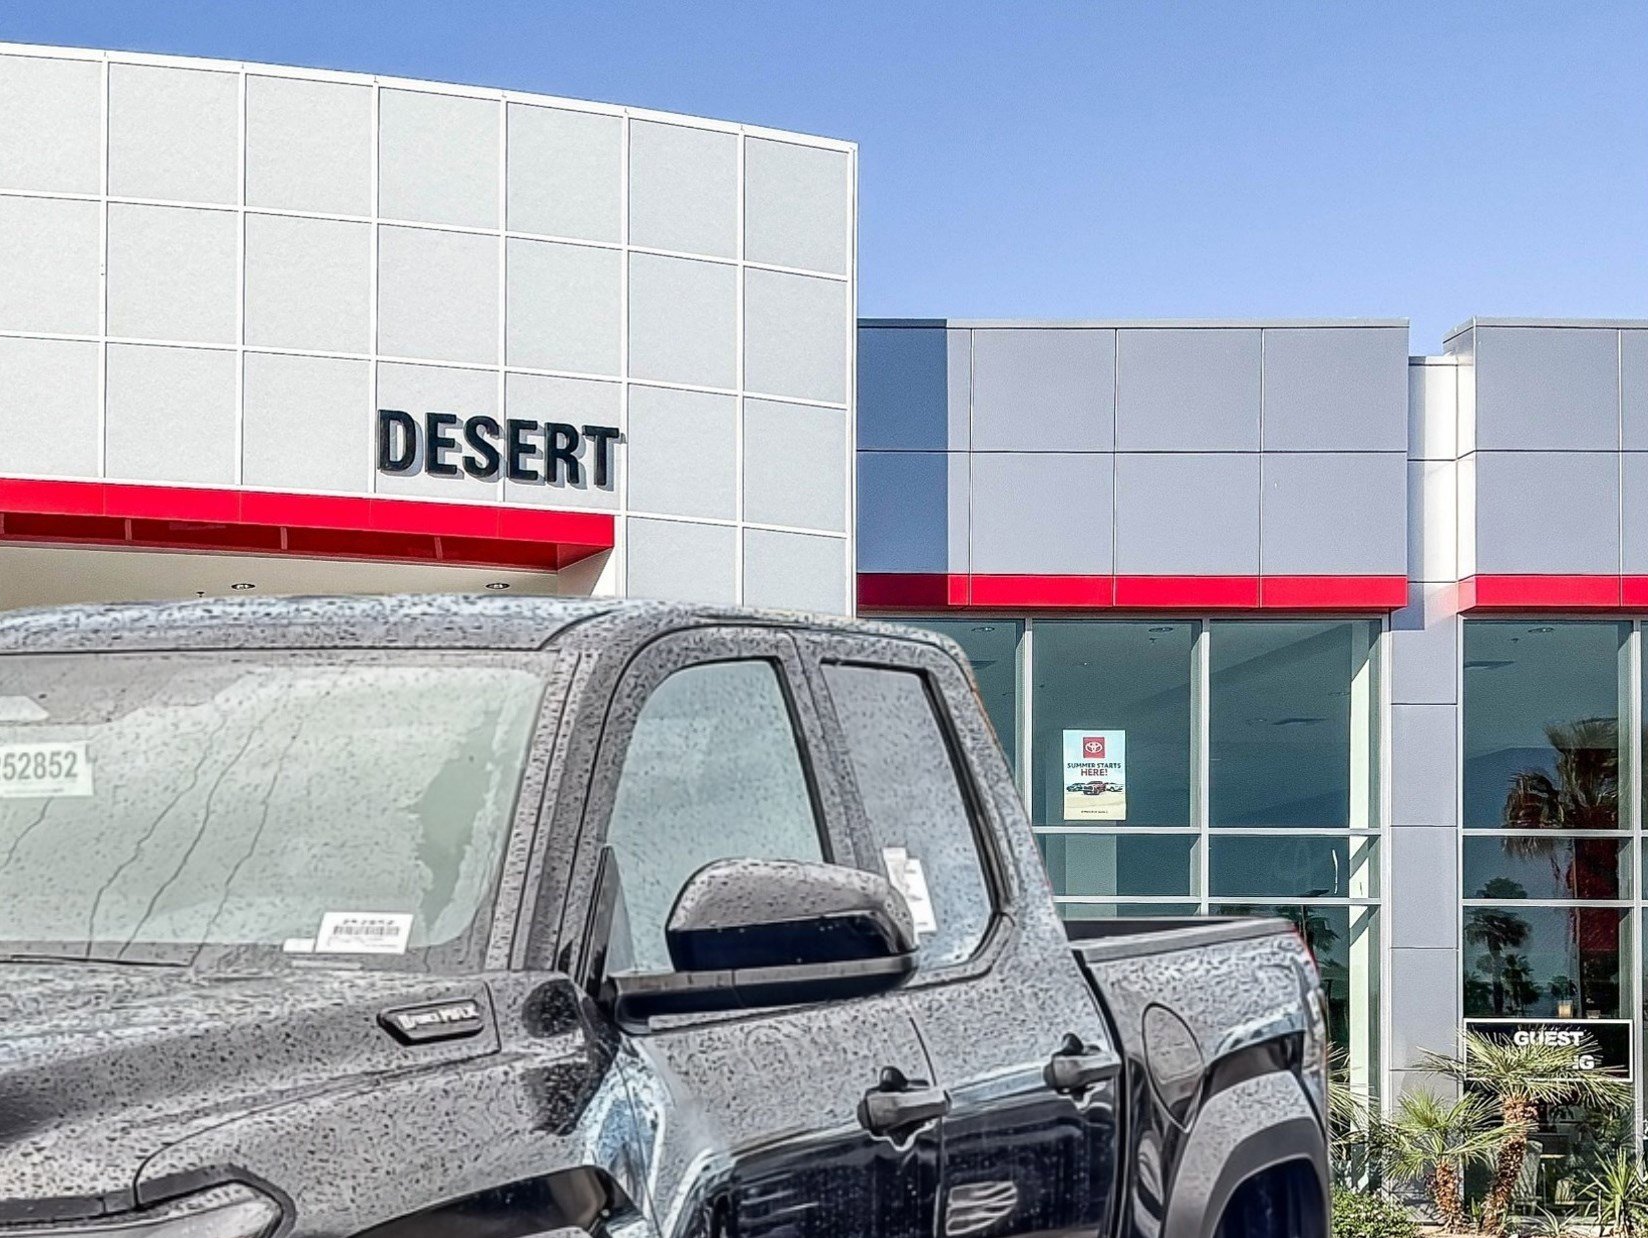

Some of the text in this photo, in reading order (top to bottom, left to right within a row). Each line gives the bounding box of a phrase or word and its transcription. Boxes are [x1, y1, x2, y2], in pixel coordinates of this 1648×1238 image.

[377, 409, 620, 487] DESERT
[1081, 768, 1108, 777] HERE!
[1513, 1030, 1585, 1047] GUEST
